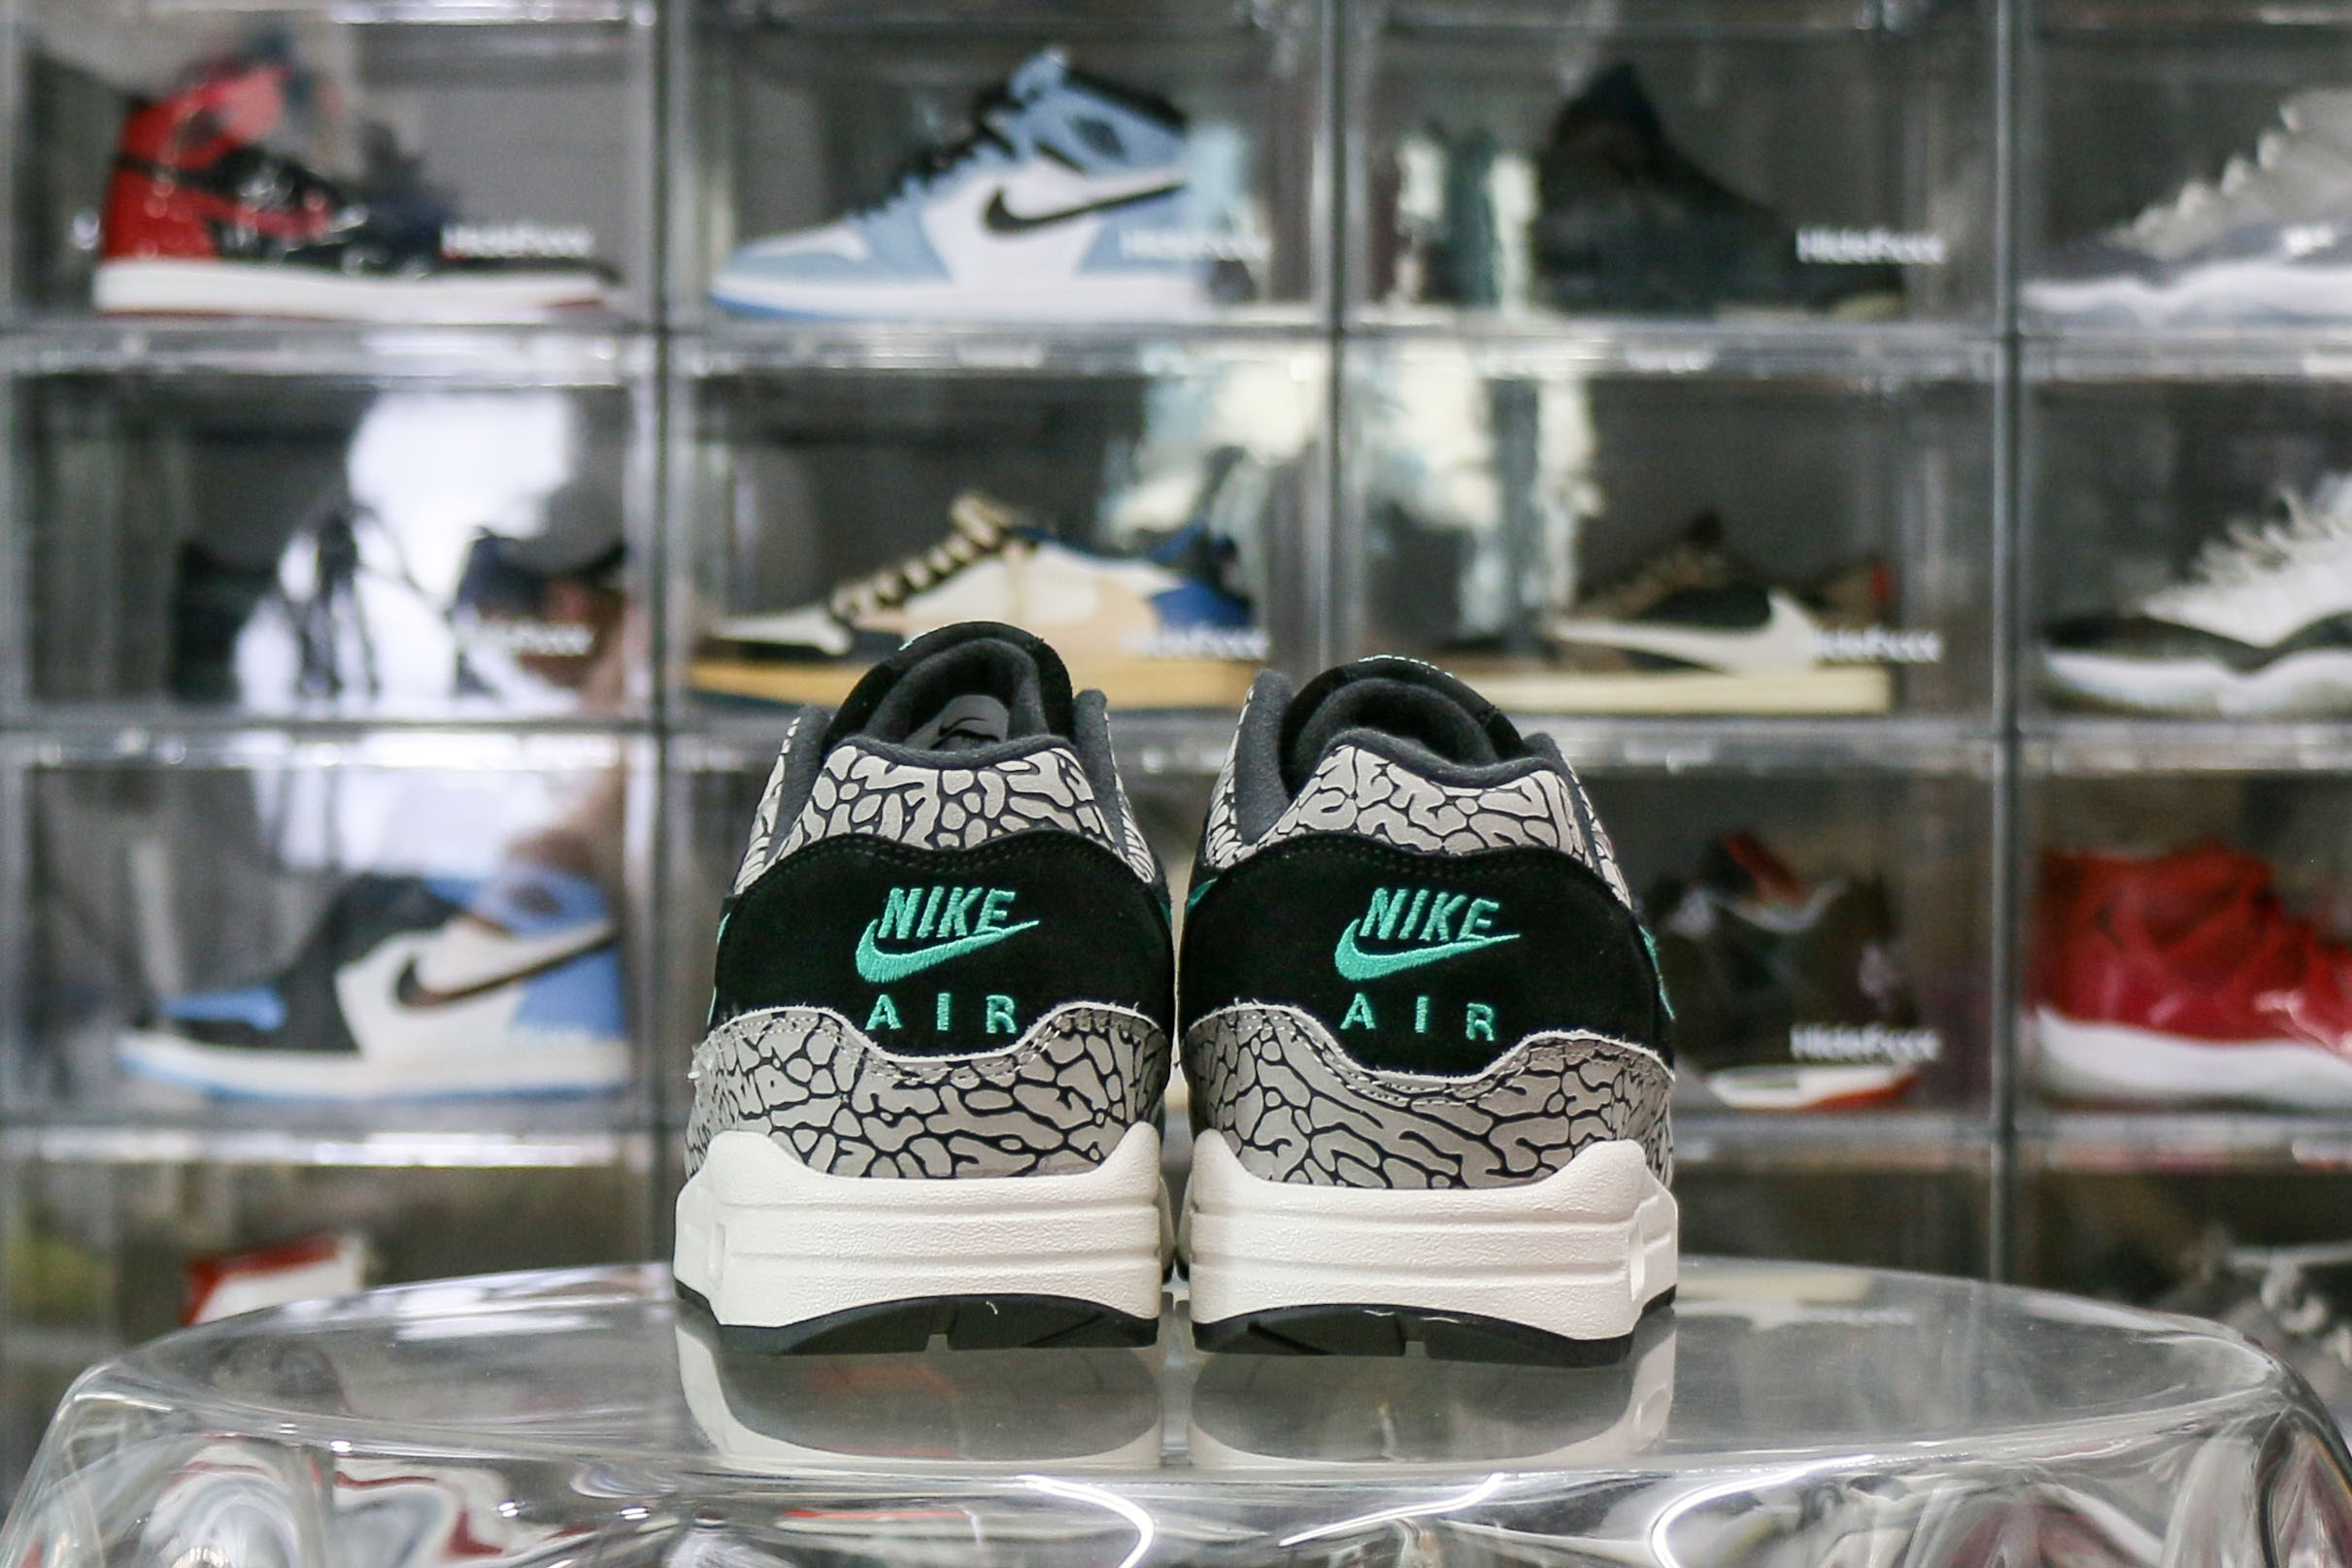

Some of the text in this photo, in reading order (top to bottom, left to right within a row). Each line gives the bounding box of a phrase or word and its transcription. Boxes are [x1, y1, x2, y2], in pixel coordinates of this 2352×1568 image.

[877, 885, 1016, 939] NIKE
[1359, 887, 1499, 941] NIKE
[864, 992, 1017, 1034] AIR
[1339, 992, 1495, 1041] AIR
